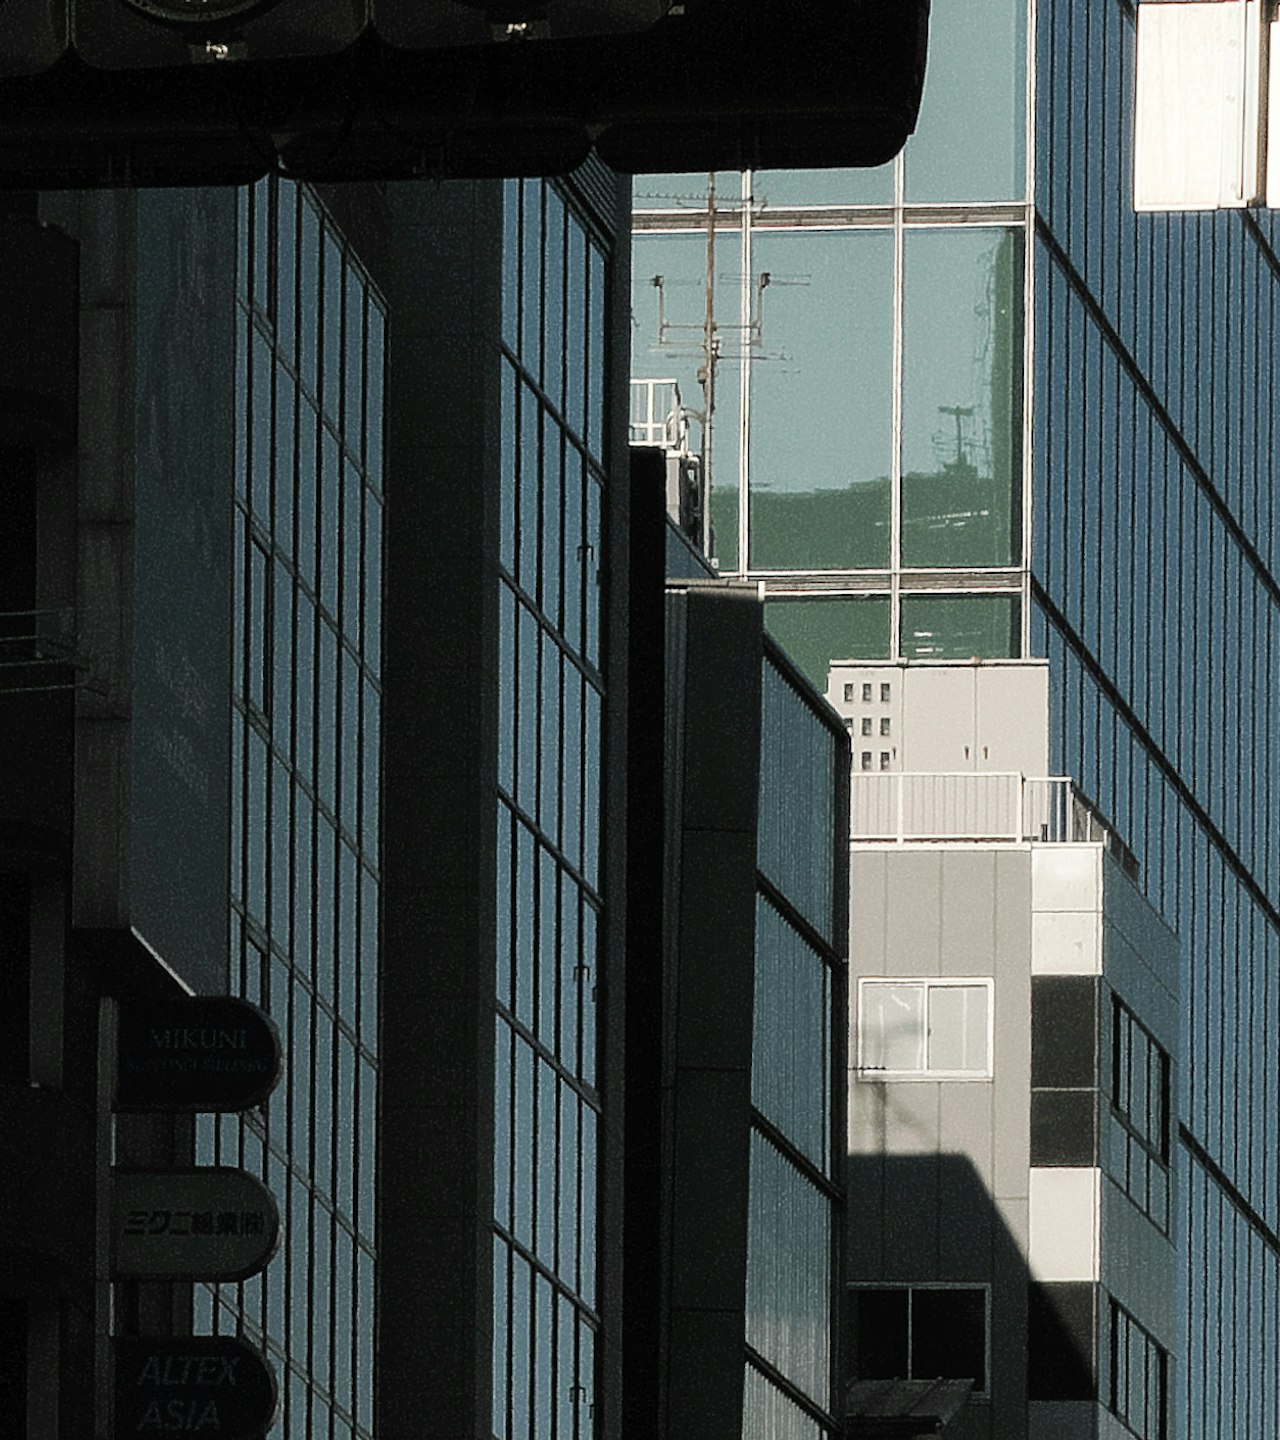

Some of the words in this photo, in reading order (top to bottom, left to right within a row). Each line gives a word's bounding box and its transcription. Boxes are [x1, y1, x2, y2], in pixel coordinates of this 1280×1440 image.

[150, 1028, 247, 1049] MIKUNI
[137, 1356, 240, 1386] ALTEX
[137, 1400, 221, 1431] ASIA
